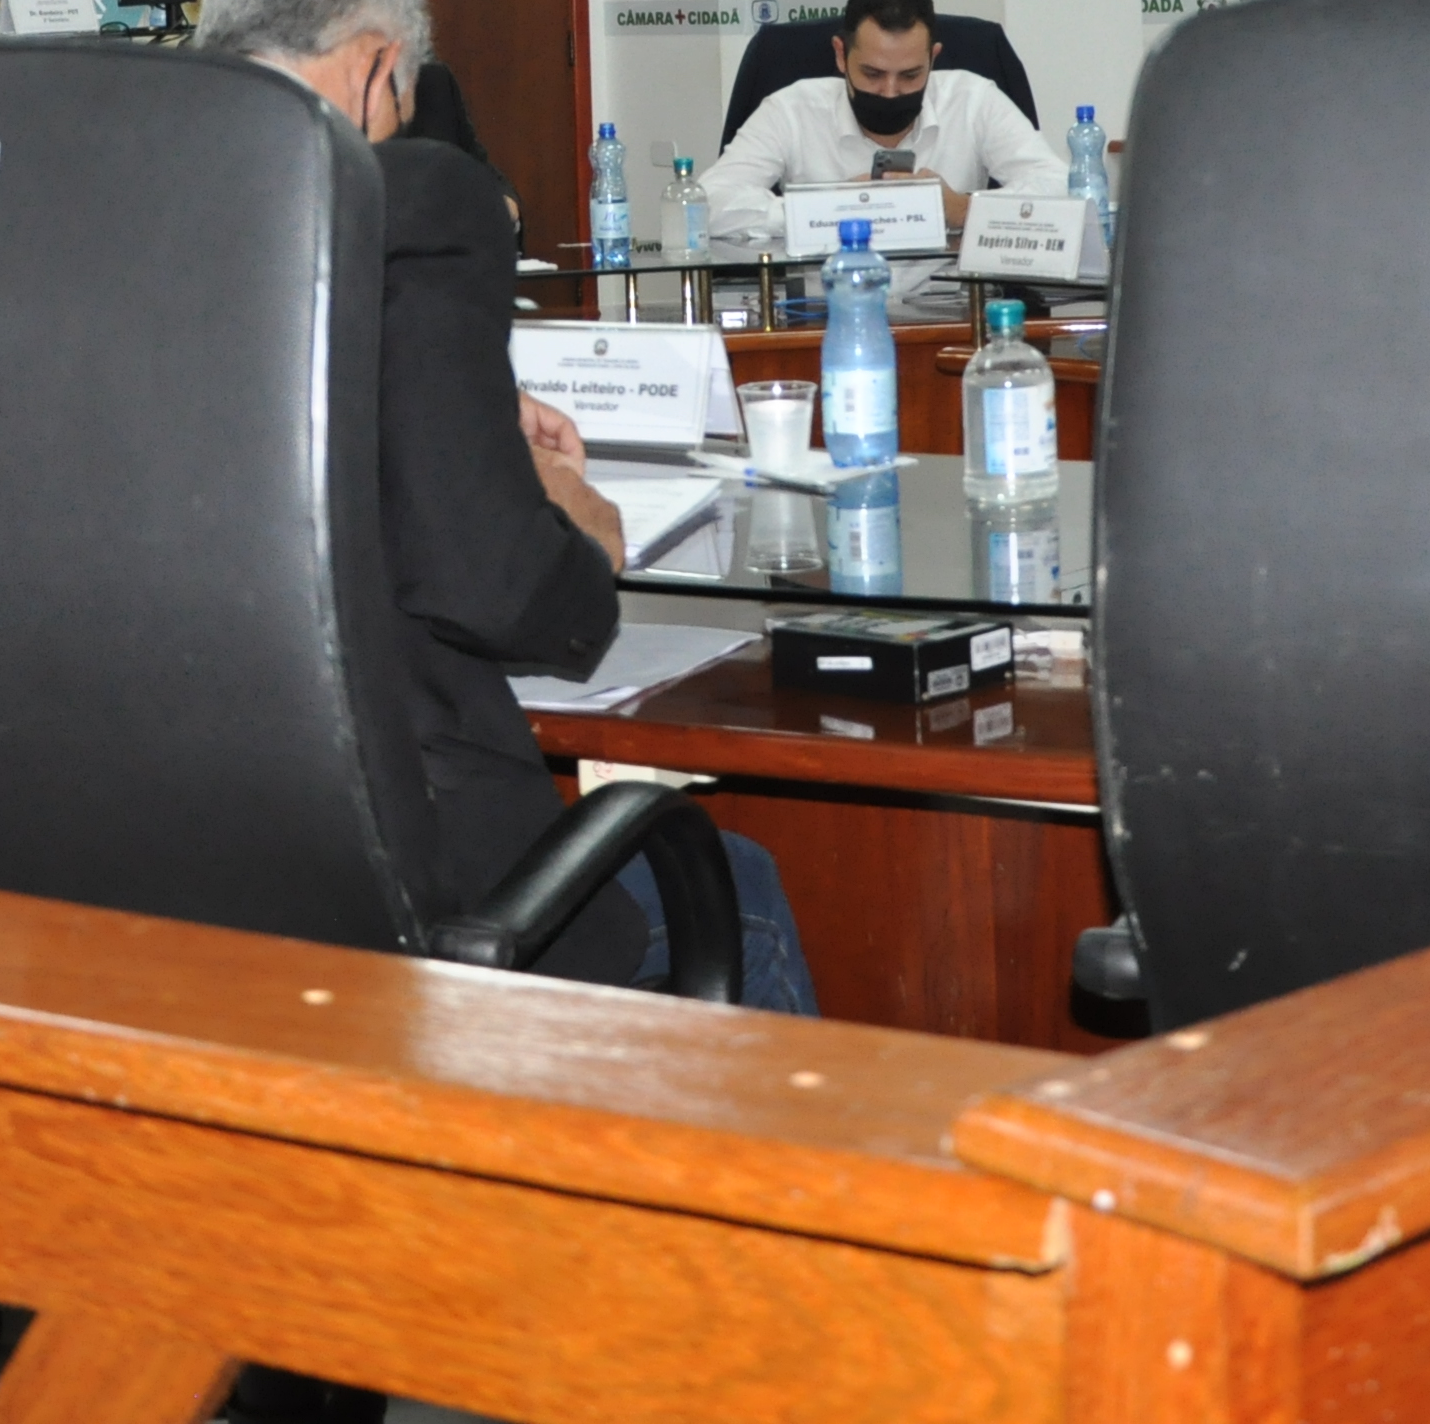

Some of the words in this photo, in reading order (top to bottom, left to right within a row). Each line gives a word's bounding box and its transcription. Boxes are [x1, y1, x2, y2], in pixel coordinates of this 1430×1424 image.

[906, 214, 927, 223] PSL
[978, 234, 1012, 251] Rogério
[1013, 236, 1039, 251] Silva
[1045, 238, 1065, 251] DEM
[1000, 256, 1034, 267] Vereador
[519, 380, 568, 393] Nivaldo
[572, 381, 626, 395] Leiteiro
[638, 384, 678, 397] PODE
[574, 400, 619, 412] Vereador
